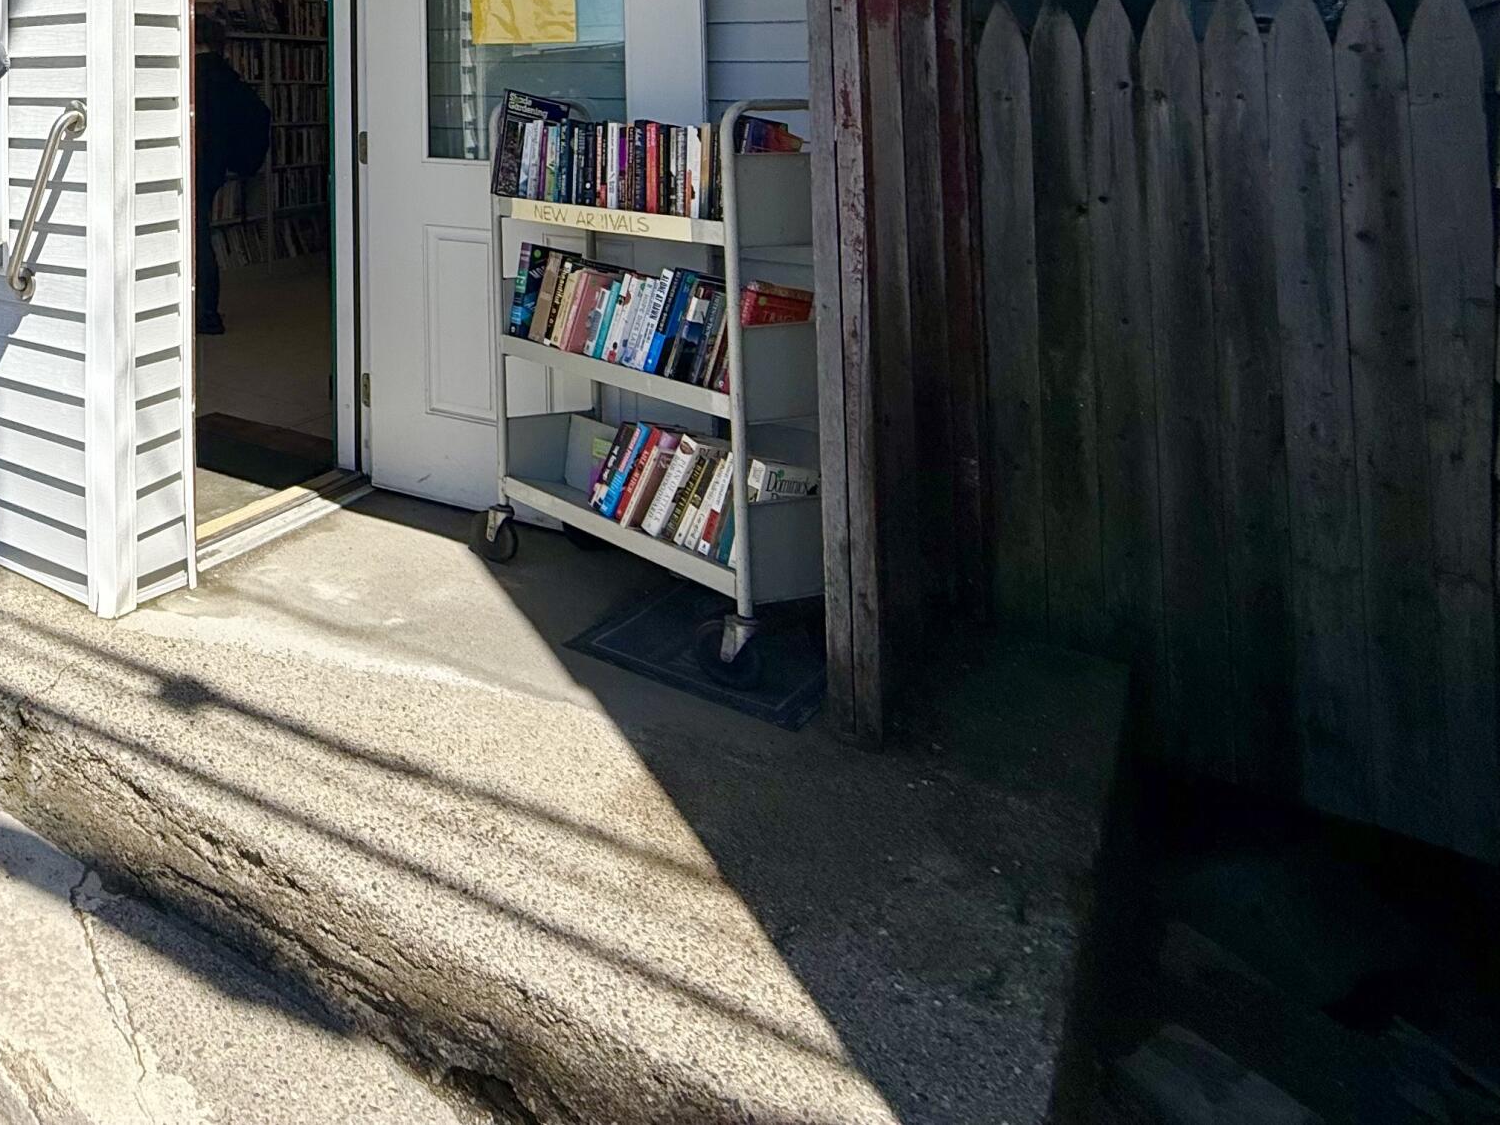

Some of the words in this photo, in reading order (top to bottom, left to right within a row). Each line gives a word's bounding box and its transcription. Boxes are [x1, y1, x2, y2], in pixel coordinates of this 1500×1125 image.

[508, 101, 548, 120] Gardening
[533, 205, 568, 223] NEW
[659, 275, 669, 294] ALONE
[650, 302, 661, 321] DAWN
